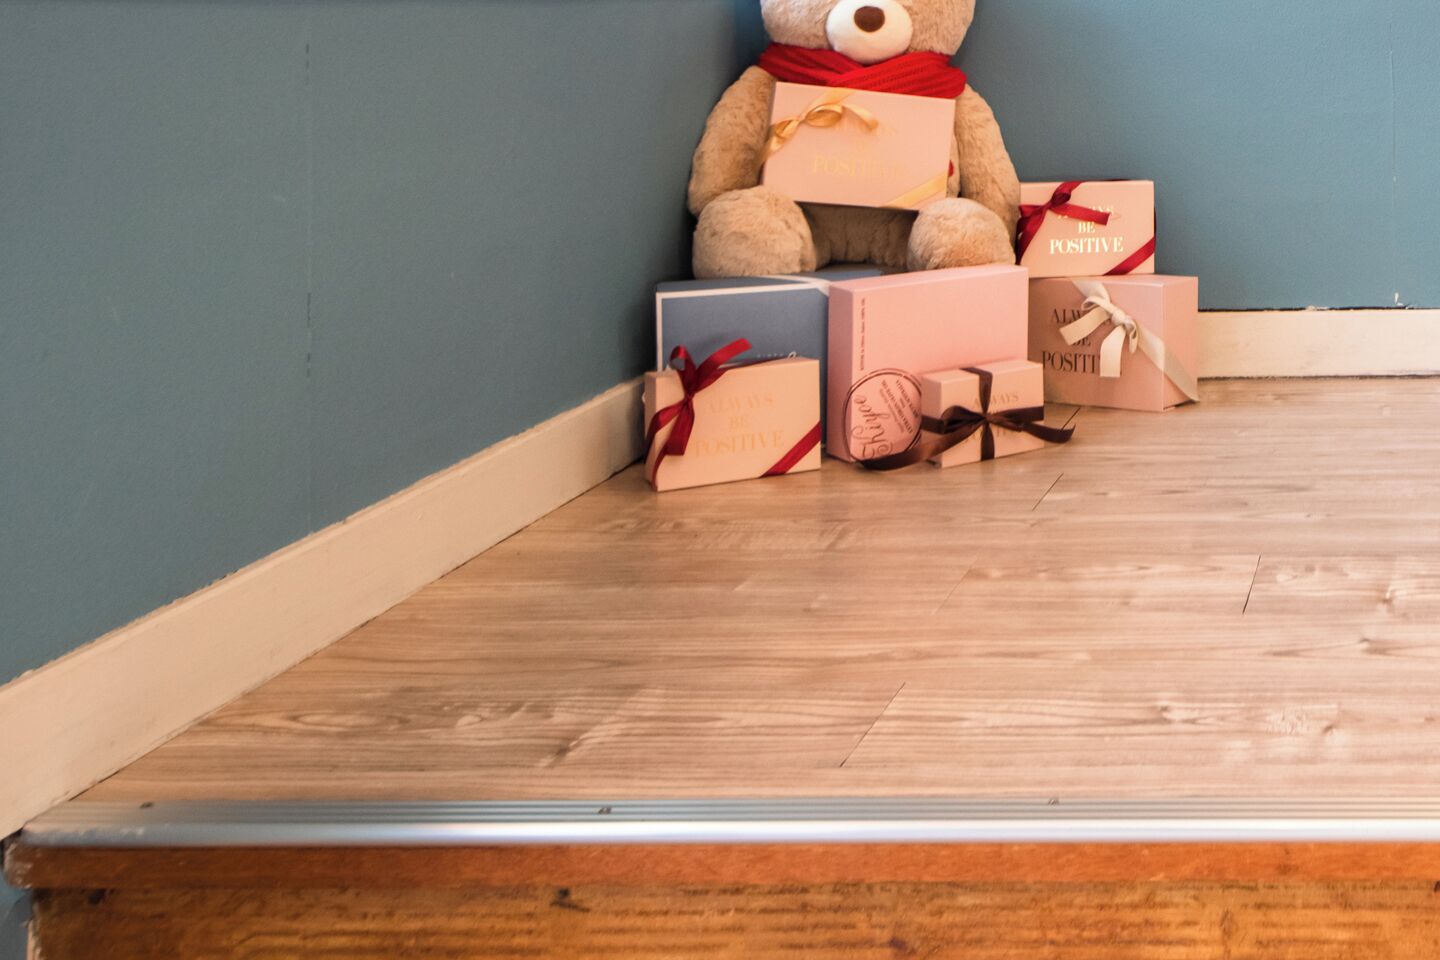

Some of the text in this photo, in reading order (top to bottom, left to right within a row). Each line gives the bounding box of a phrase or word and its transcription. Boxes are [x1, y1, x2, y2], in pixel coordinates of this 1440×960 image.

[1078, 221, 1095, 234] BE
[1050, 236, 1124, 255] POSITIVE
[1042, 351, 1107, 374] POSITI
[695, 431, 784, 457] POSITIVE
